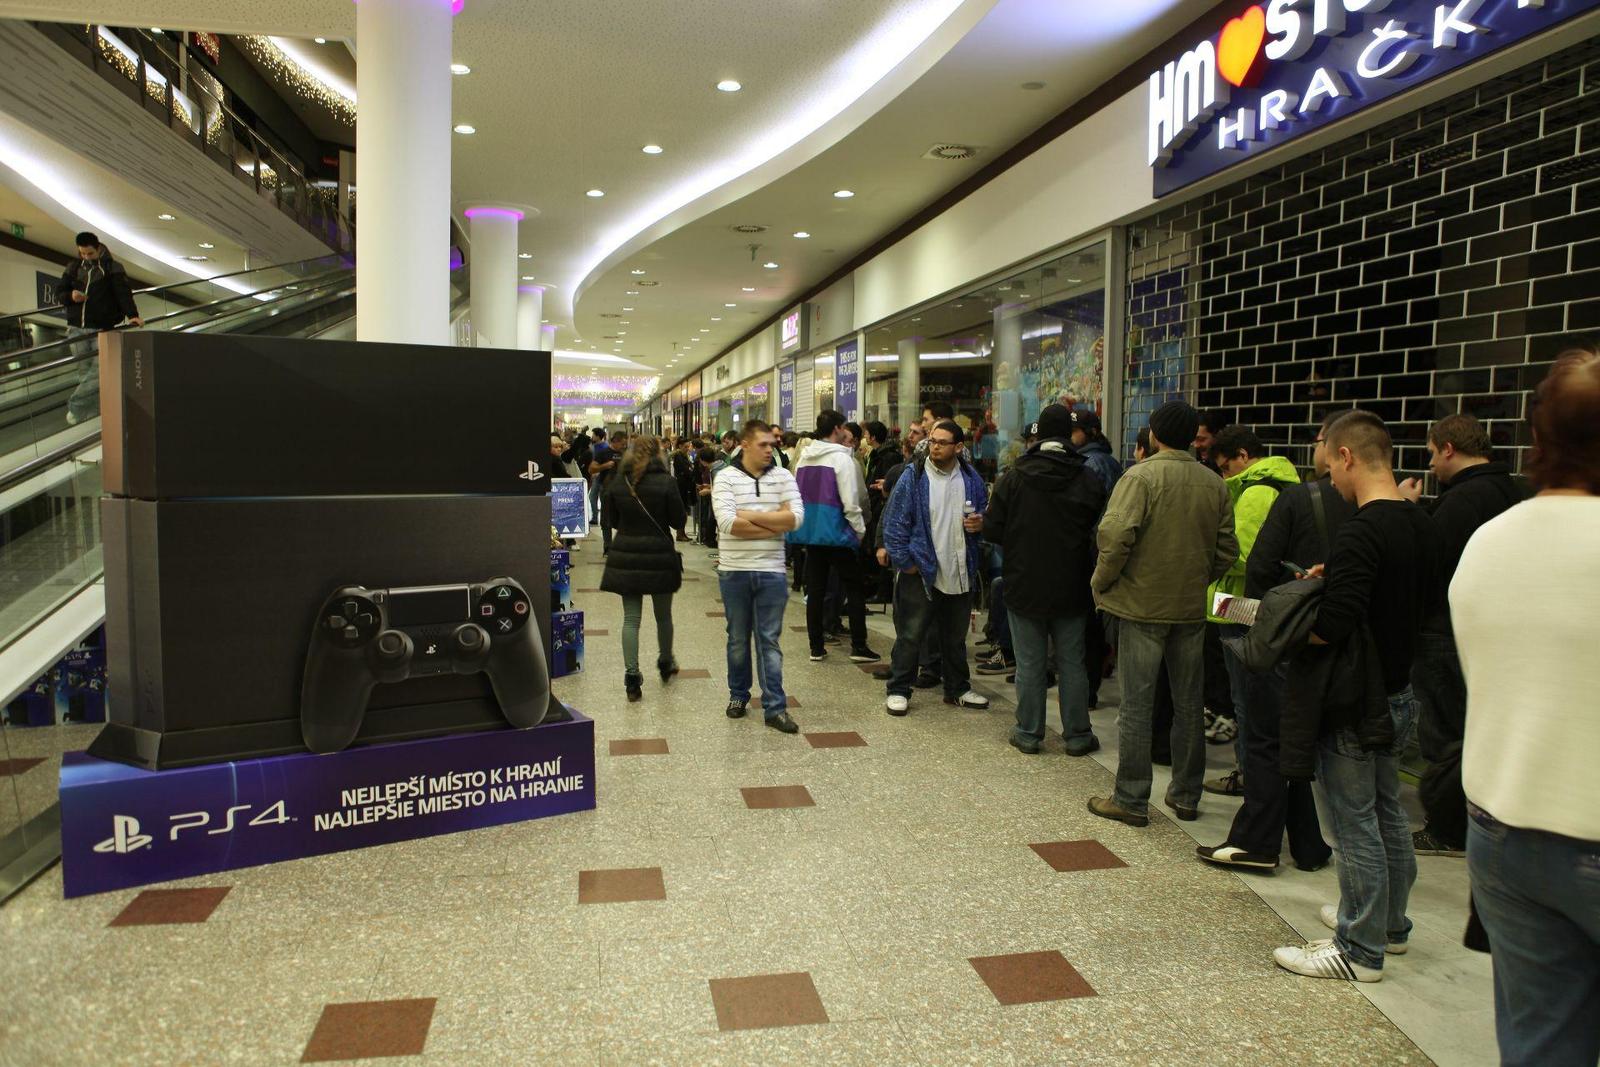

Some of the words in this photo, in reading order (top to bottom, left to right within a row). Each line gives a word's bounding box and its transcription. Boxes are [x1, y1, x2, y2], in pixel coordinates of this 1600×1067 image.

[1218, 0, 1528, 150] HRAČK
[134, 348, 143, 391] SONY
[314, 799, 415, 832] NAJLEPŠIE
[418, 790, 487, 816] MIESTO
[490, 785, 517, 804] NA
[520, 774, 584, 799] HRANIE
[341, 775, 426, 808] NEJLEPŠÍ
[429, 771, 487, 794] MÍSTO
[490, 768, 503, 785] K
[506, 755, 562, 783] HRANÍ
[169, 799, 290, 841] PS4
